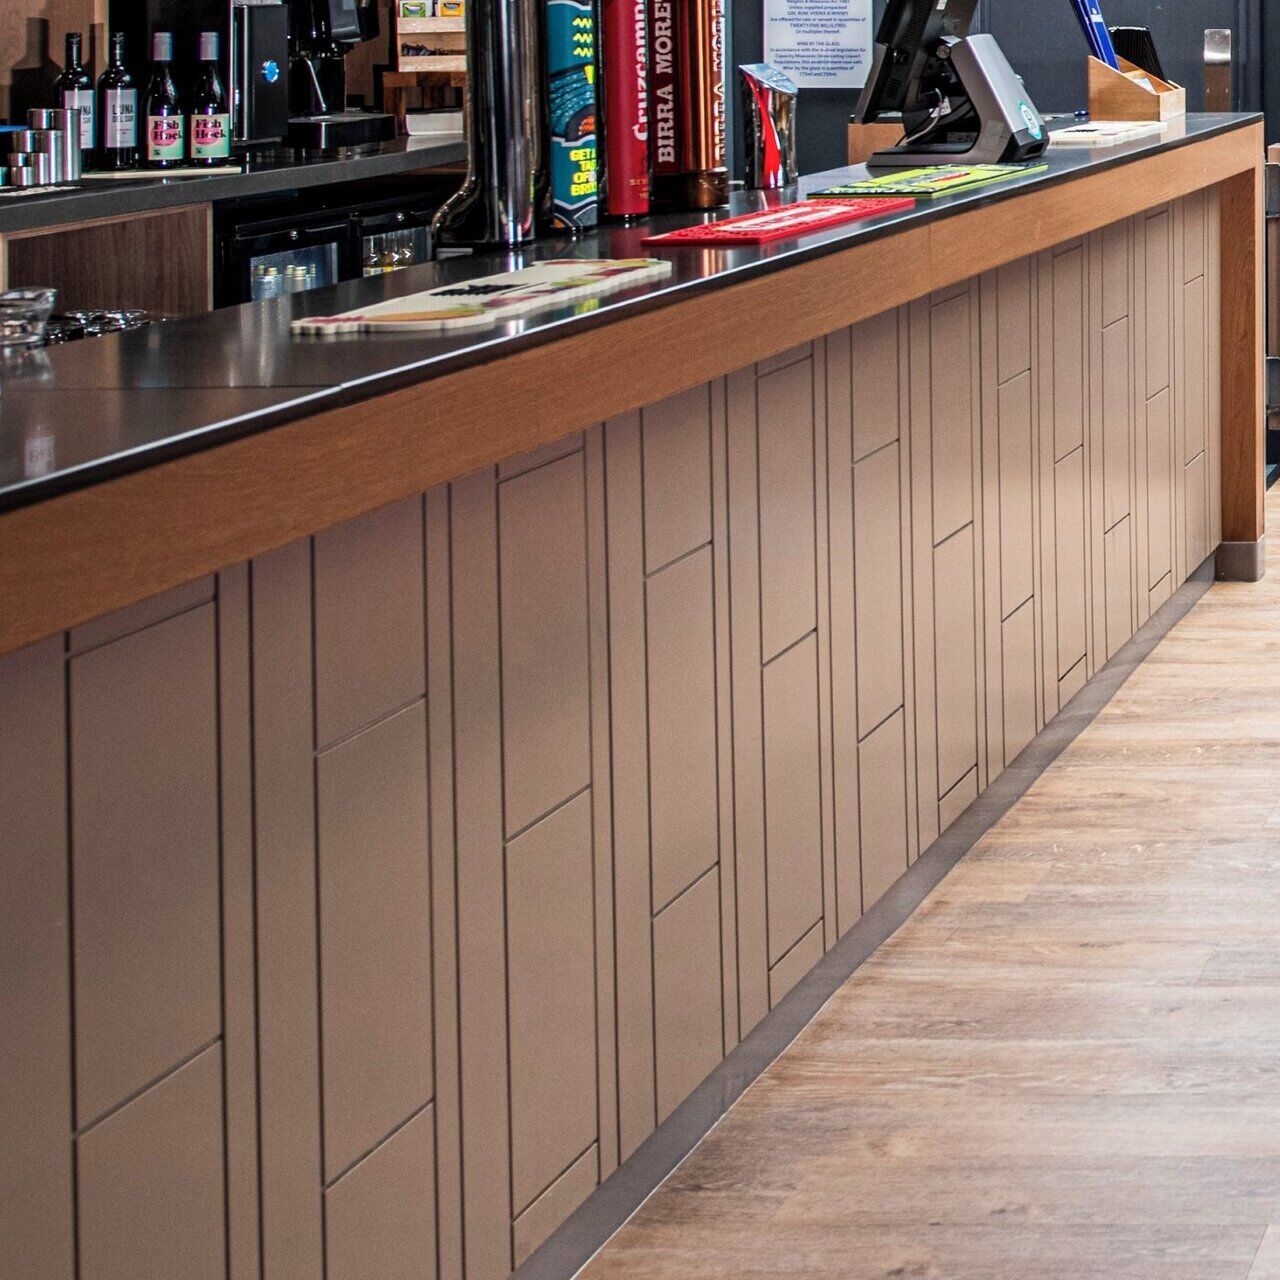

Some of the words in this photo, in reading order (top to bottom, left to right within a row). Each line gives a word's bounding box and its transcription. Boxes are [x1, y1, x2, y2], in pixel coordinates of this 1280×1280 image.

[154, 120, 179, 130] Fish
[196, 119, 221, 128] Fish
[657, 84, 675, 162] BIRRA
